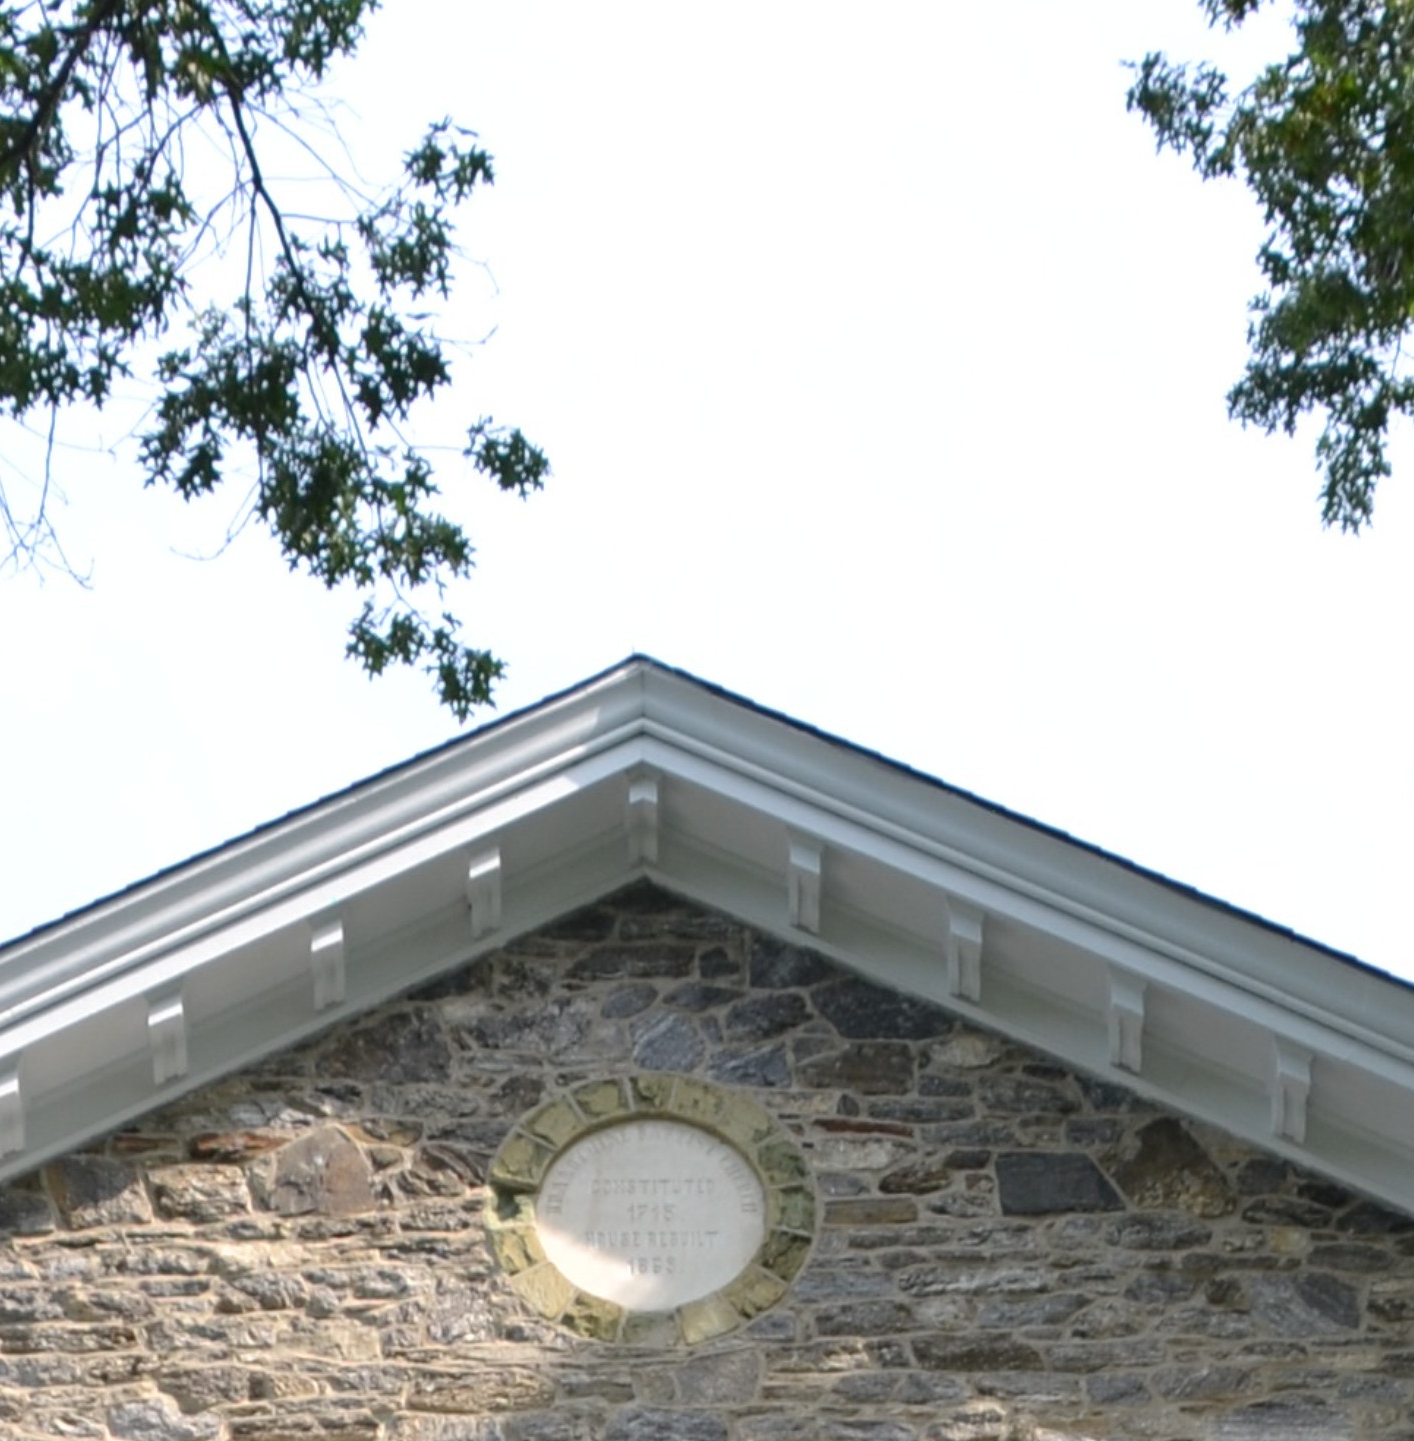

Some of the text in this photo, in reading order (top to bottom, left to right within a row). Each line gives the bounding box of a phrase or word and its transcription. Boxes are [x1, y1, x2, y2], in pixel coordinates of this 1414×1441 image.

[591, 1178, 715, 1195] CONSTITUTED
[584, 1230, 720, 1248] HOUSE REBUILT
